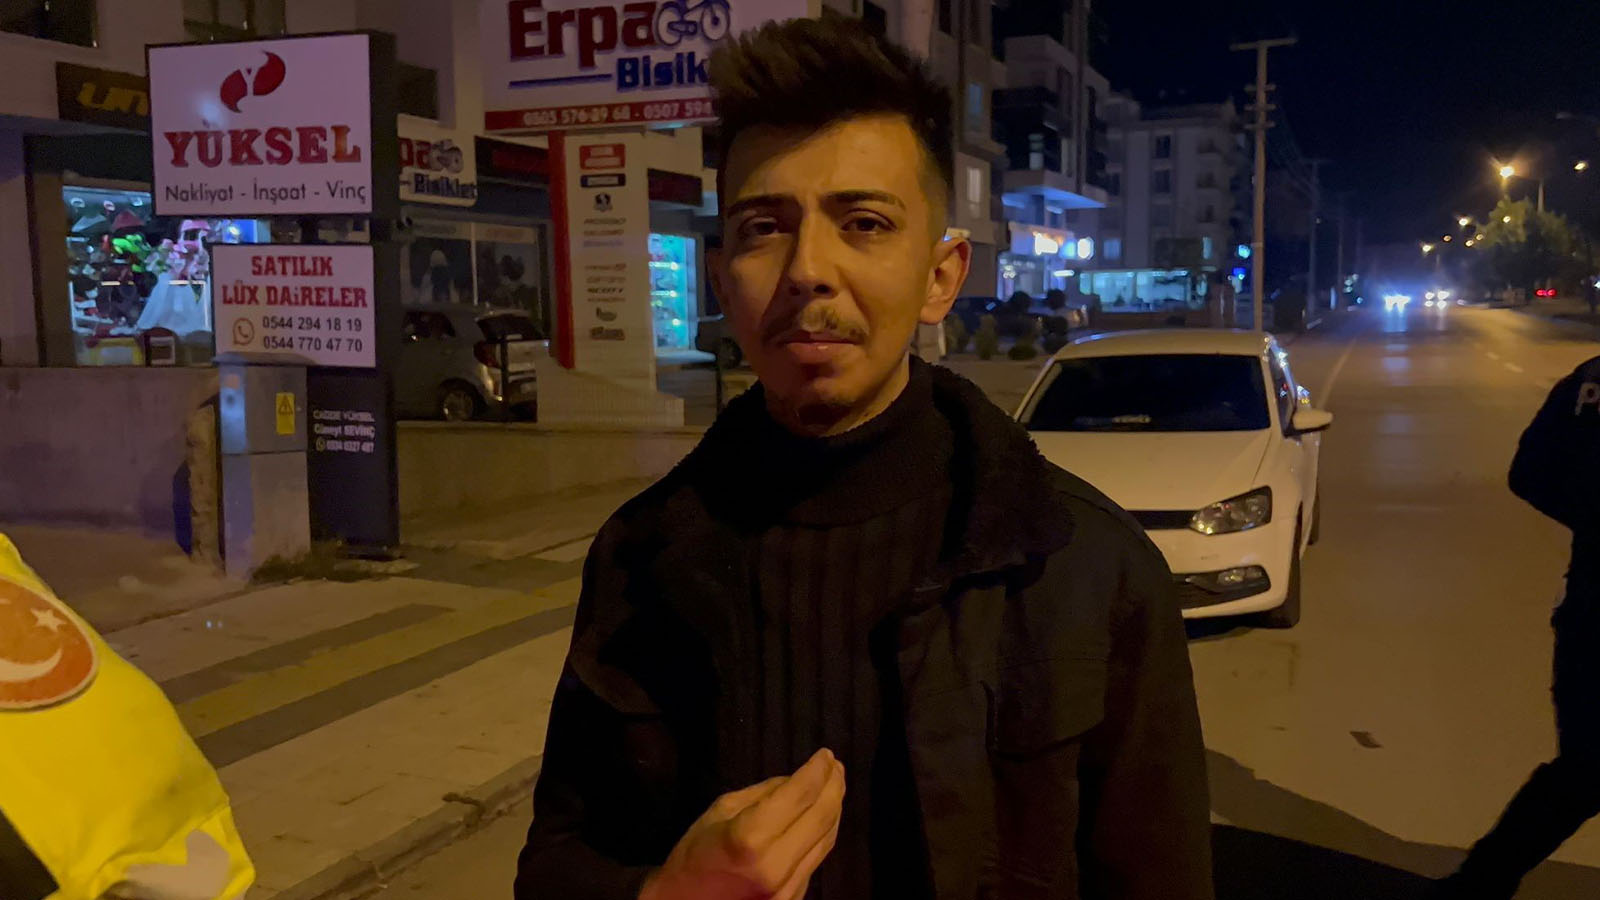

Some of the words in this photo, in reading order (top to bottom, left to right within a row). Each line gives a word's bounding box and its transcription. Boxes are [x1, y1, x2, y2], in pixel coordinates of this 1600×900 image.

[508, 0, 657, 71] Erpa
[164, 119, 361, 168] YÜKSEL
[165, 182, 234, 205] Nakliyat
[253, 177, 306, 205] İnşaat
[326, 179, 366, 204] Vinç
[252, 256, 333, 277] SATILIK
[222, 280, 259, 305] LÜX
[263, 316, 293, 329] 0544
[298, 317, 321, 331] 294
[327, 318, 341, 331] 18
[347, 319, 362, 332] 19
[263, 336, 294, 350] 0544
[299, 337, 321, 351] 770
[326, 338, 341, 351] 47
[347, 339, 363, 352] 70
